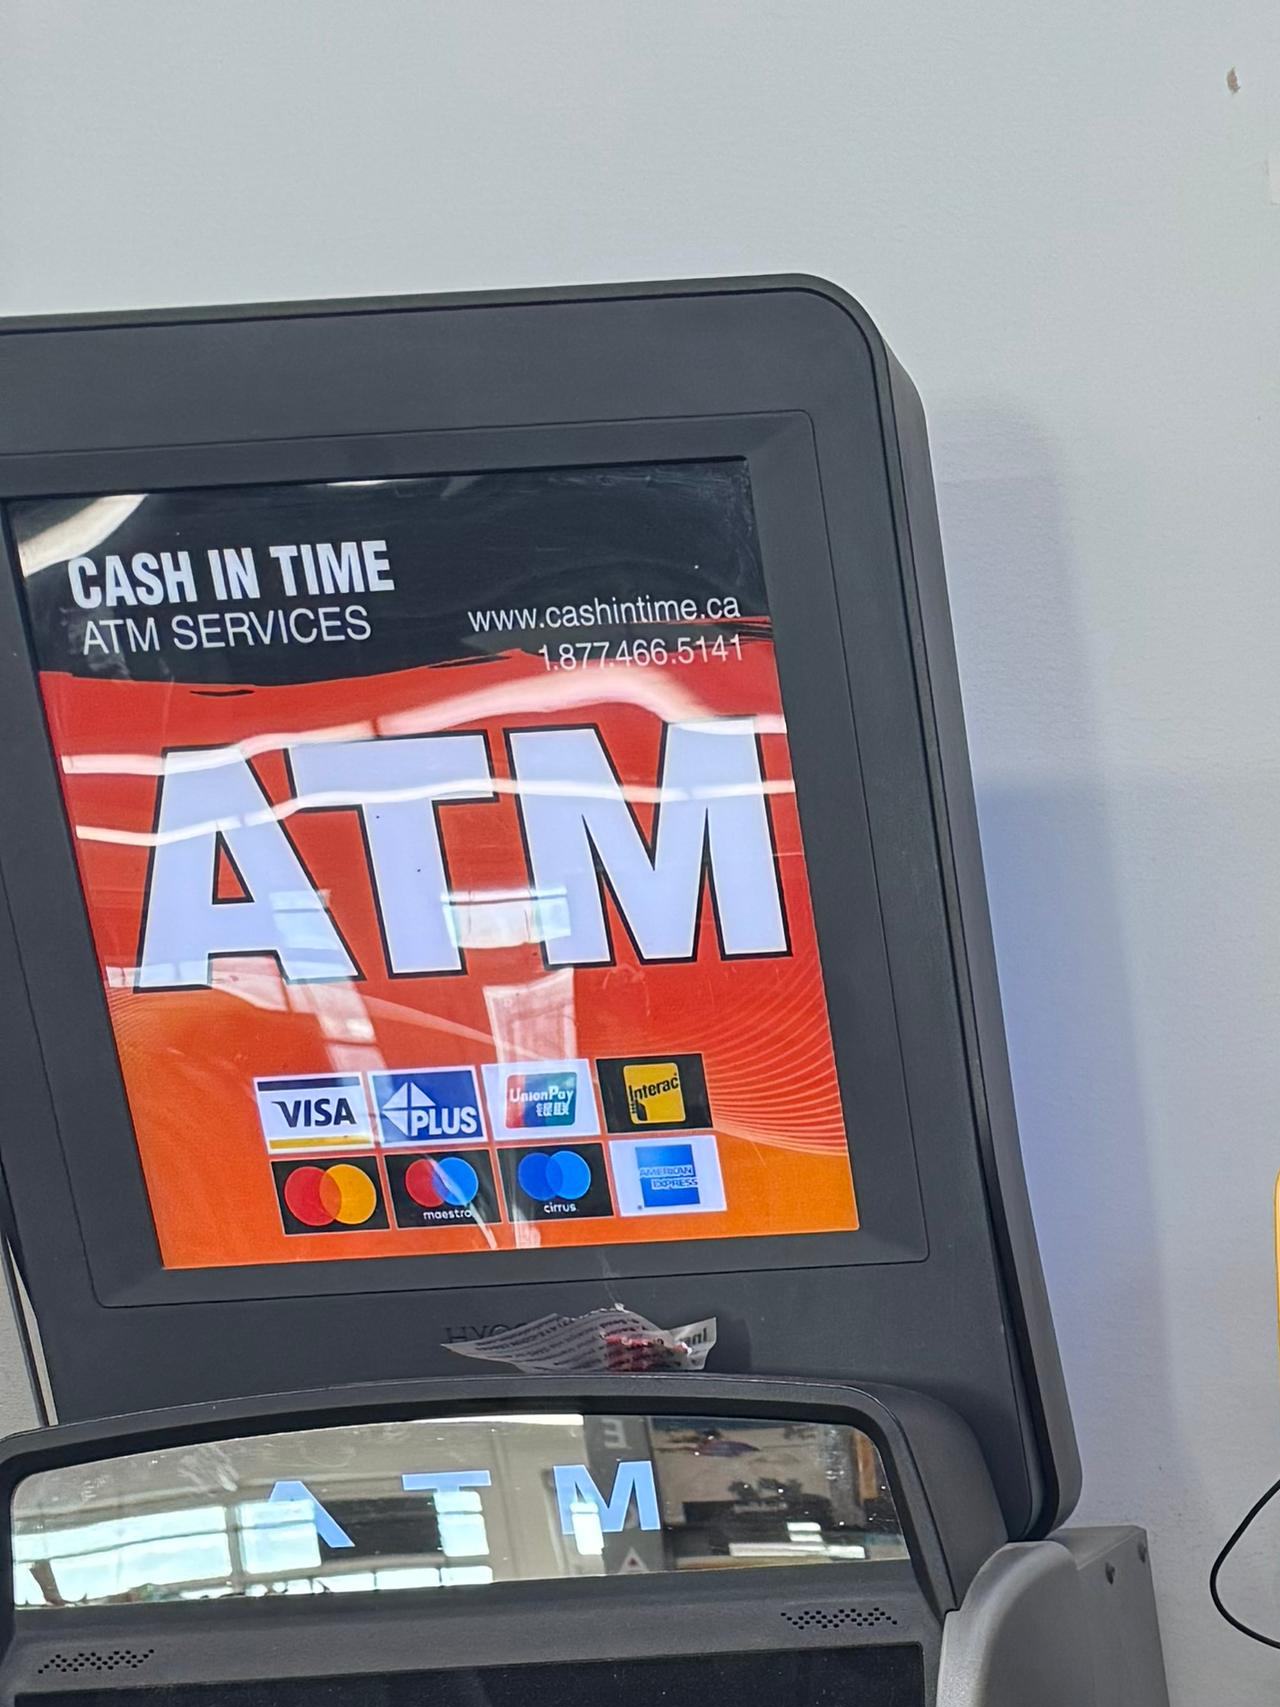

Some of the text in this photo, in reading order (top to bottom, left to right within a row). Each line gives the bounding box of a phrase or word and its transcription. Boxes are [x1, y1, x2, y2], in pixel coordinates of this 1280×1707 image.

[68, 540, 395, 609] CASH IN TIME
[468, 595, 741, 632] www.cashintime.ca
[82, 606, 372, 655] ATM SERVICES
[538, 634, 743, 671] 1.877.466.5141
[134, 716, 791, 991] ATM
[509, 1087, 575, 1104] UnionPay
[628, 1075, 679, 1102] Interac
[272, 1098, 358, 1128] VISA
[411, 1107, 478, 1136] PLUS
[639, 1167, 694, 1177] AMERICAN
[651, 1178, 699, 1189] EXPRESS
[423, 1207, 472, 1220] maestro
[543, 1201, 577, 1214] cirrus
